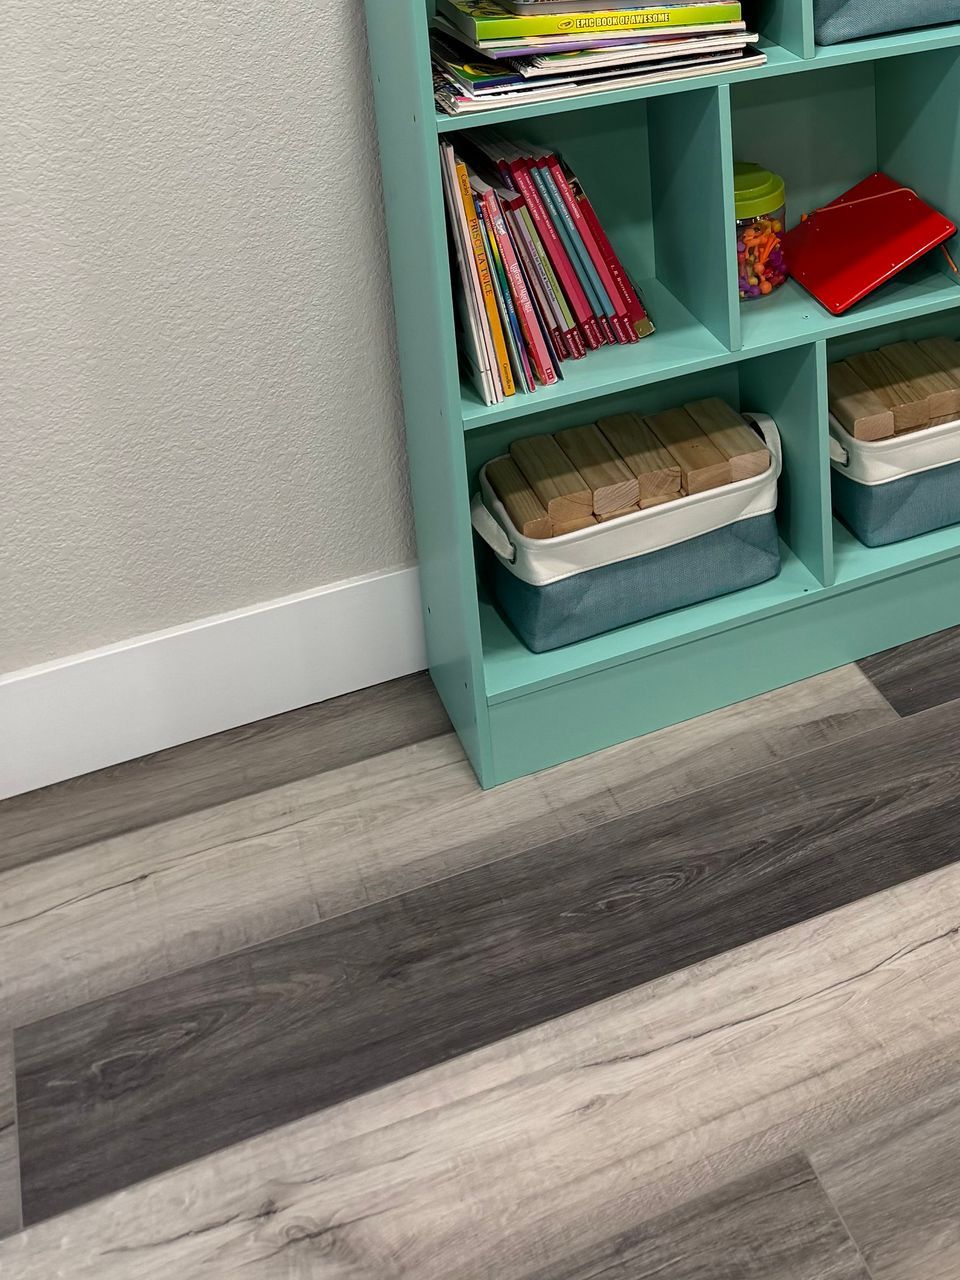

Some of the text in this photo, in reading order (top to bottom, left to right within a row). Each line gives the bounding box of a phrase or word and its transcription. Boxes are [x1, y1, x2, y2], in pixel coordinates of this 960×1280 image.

[576, 18, 595, 28] EPIC
[596, 17, 618, 27] BOOK
[620, 16, 630, 25] OF
[630, 13, 670, 24] AWESOME
[479, 267, 493, 296] TWICE
